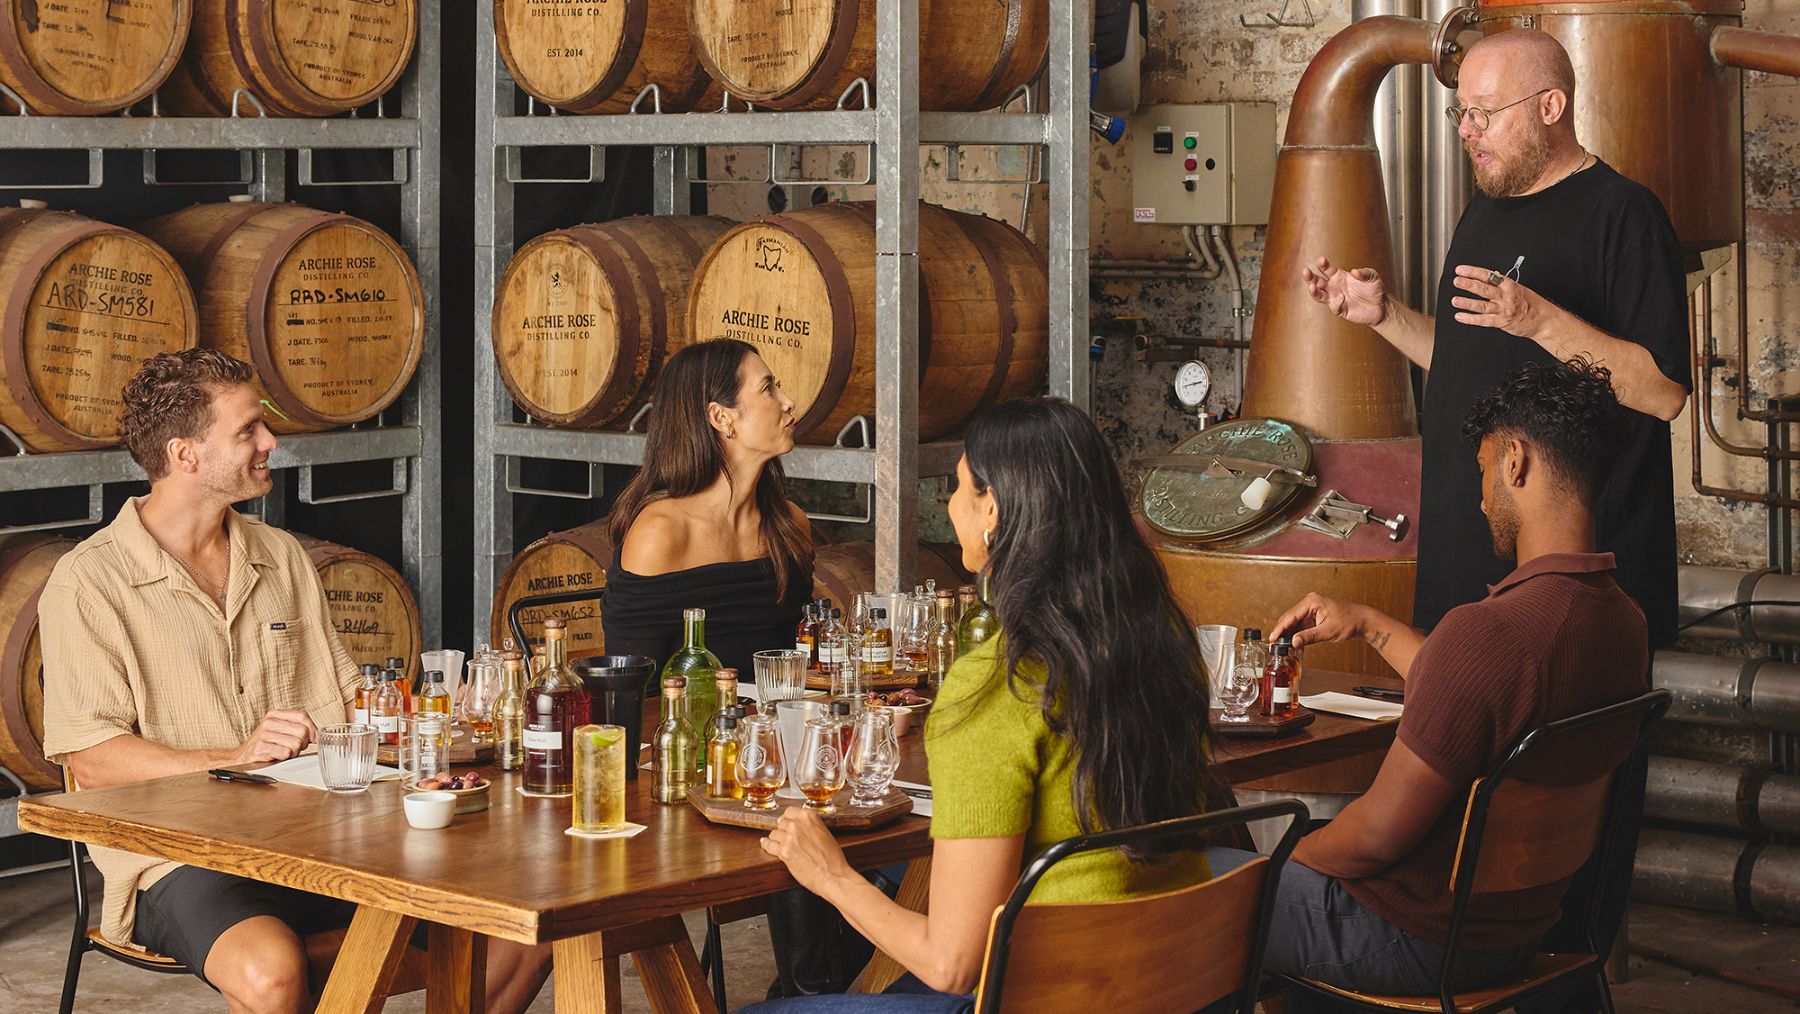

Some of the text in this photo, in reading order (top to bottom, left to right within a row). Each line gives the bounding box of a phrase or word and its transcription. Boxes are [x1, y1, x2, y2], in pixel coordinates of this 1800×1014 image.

[531, 8, 602, 17] DISTILLING CO.
[547, 48, 583, 57] EST. 2014
[299, 256, 376, 270] ARCHIE ROSE
[69, 263, 153, 286] ARCHIE ROSE
[303, 272, 354, 281] DISTILLING
[73, 279, 127, 293] DISTILLING
[46, 281, 154, 317] ARD-SM581
[522, 314, 597, 329] ARCHIE ROSE
[722, 309, 810, 336] ARCHIE ROSE
[527, 332, 576, 341] DISTILLING
[726, 329, 803, 349] DISTILLING CO.
[560, 368, 578, 377] 2014
[304, 381, 334, 389] PRODUCT
[55, 393, 88, 402] PRODUCT
[321, 389, 358, 397] AUSTRALIA
[74, 404, 112, 414] AUSTRALIA
[1268, 429, 1297, 461] ROSE
[528, 575, 564, 591] ARCHIE
[567, 572, 593, 586] ROSE
[356, 592, 383, 603] ROSE
